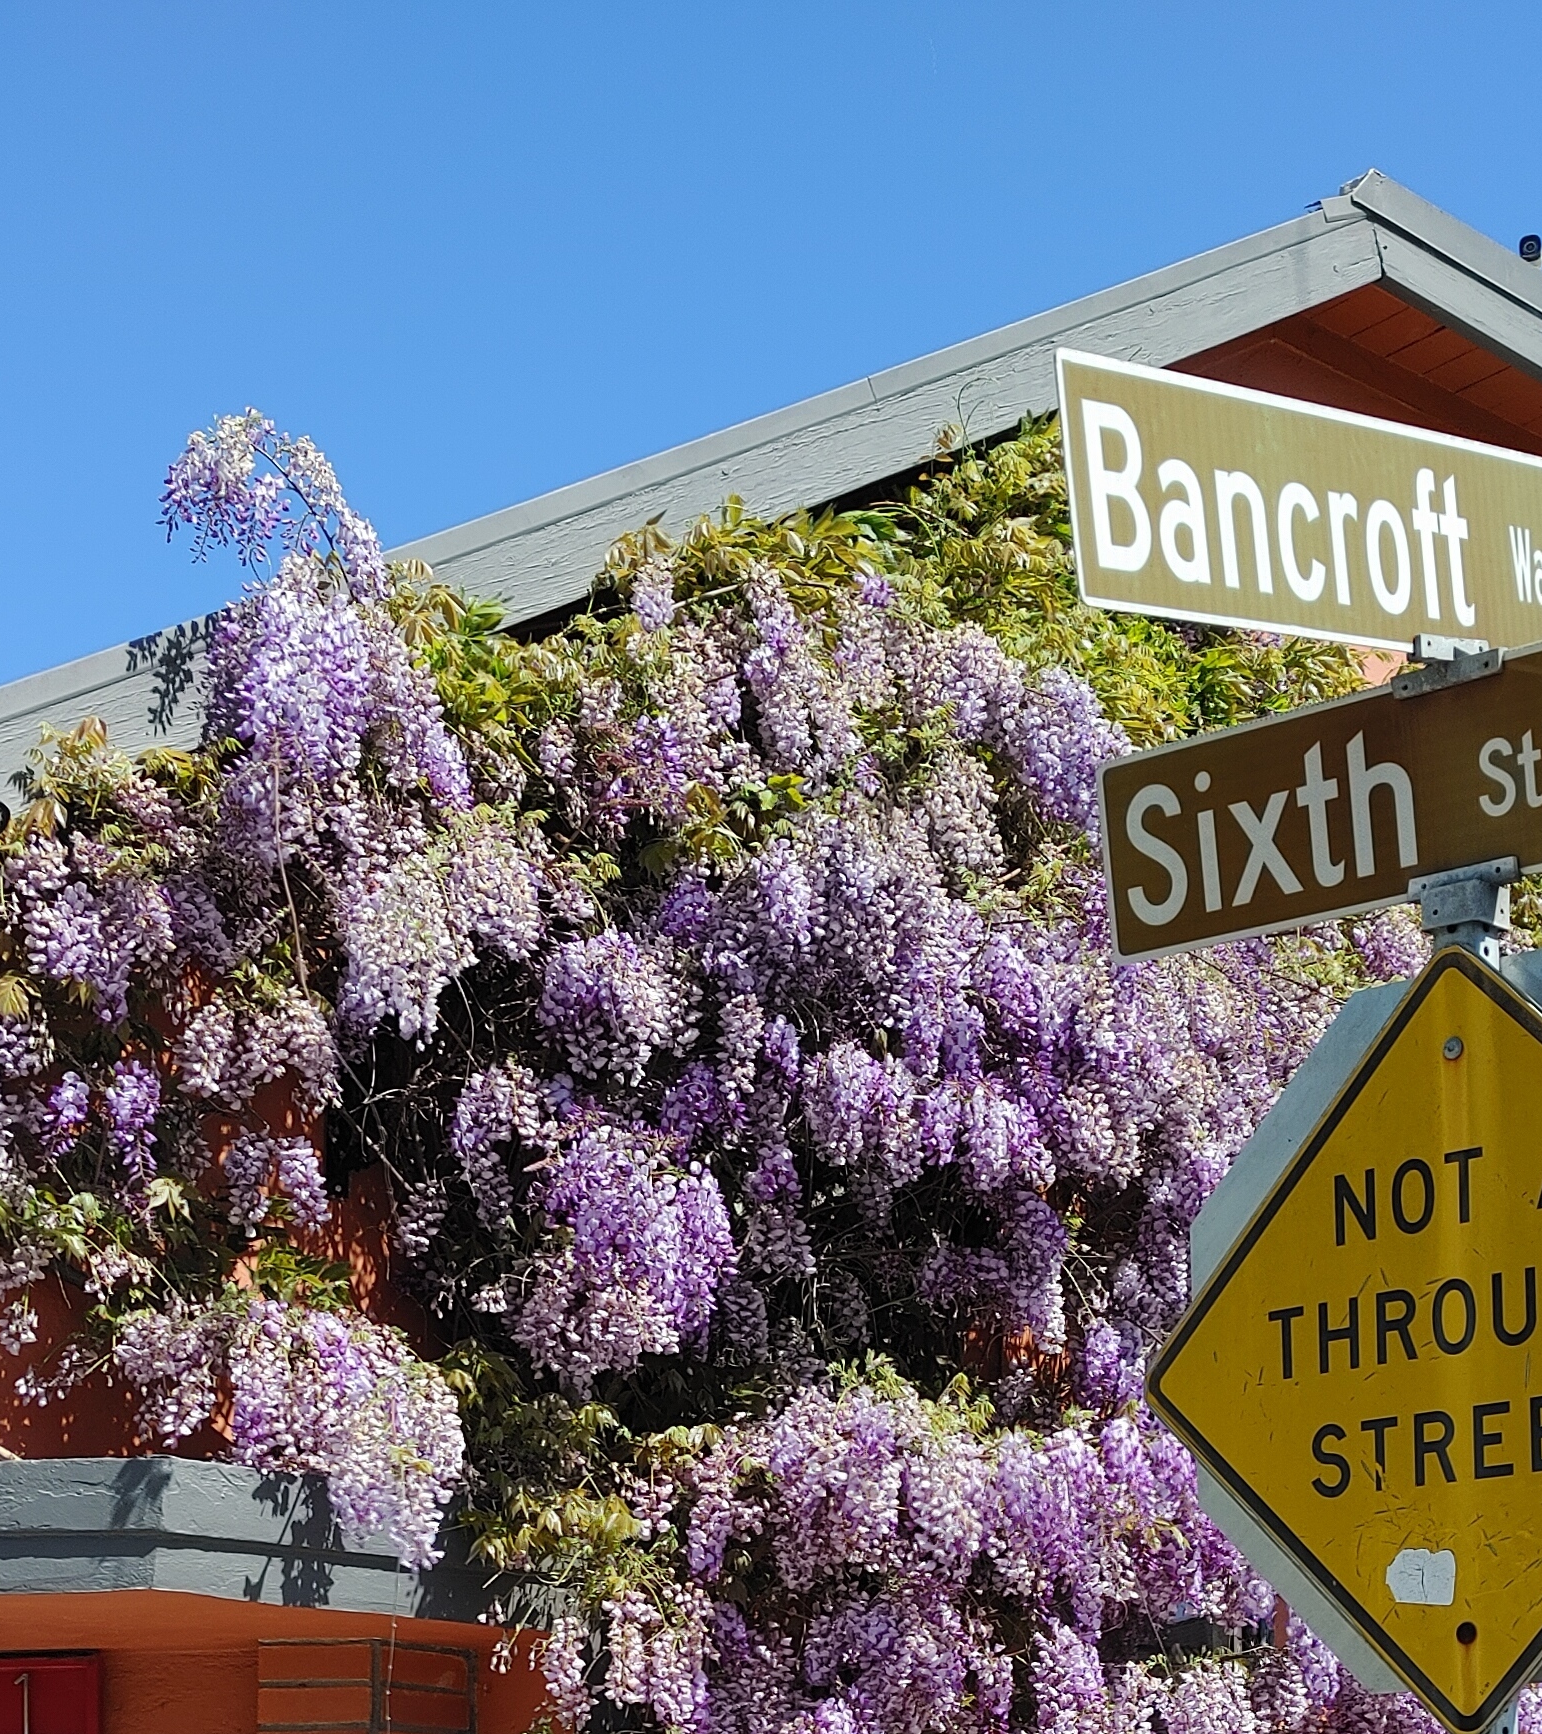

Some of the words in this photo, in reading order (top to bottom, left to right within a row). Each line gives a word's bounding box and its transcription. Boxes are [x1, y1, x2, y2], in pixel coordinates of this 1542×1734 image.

[1081, 399, 1476, 627] Bancroft
[1125, 730, 1418, 926] Sixth
[1333, 1147, 1483, 1246] NOT
